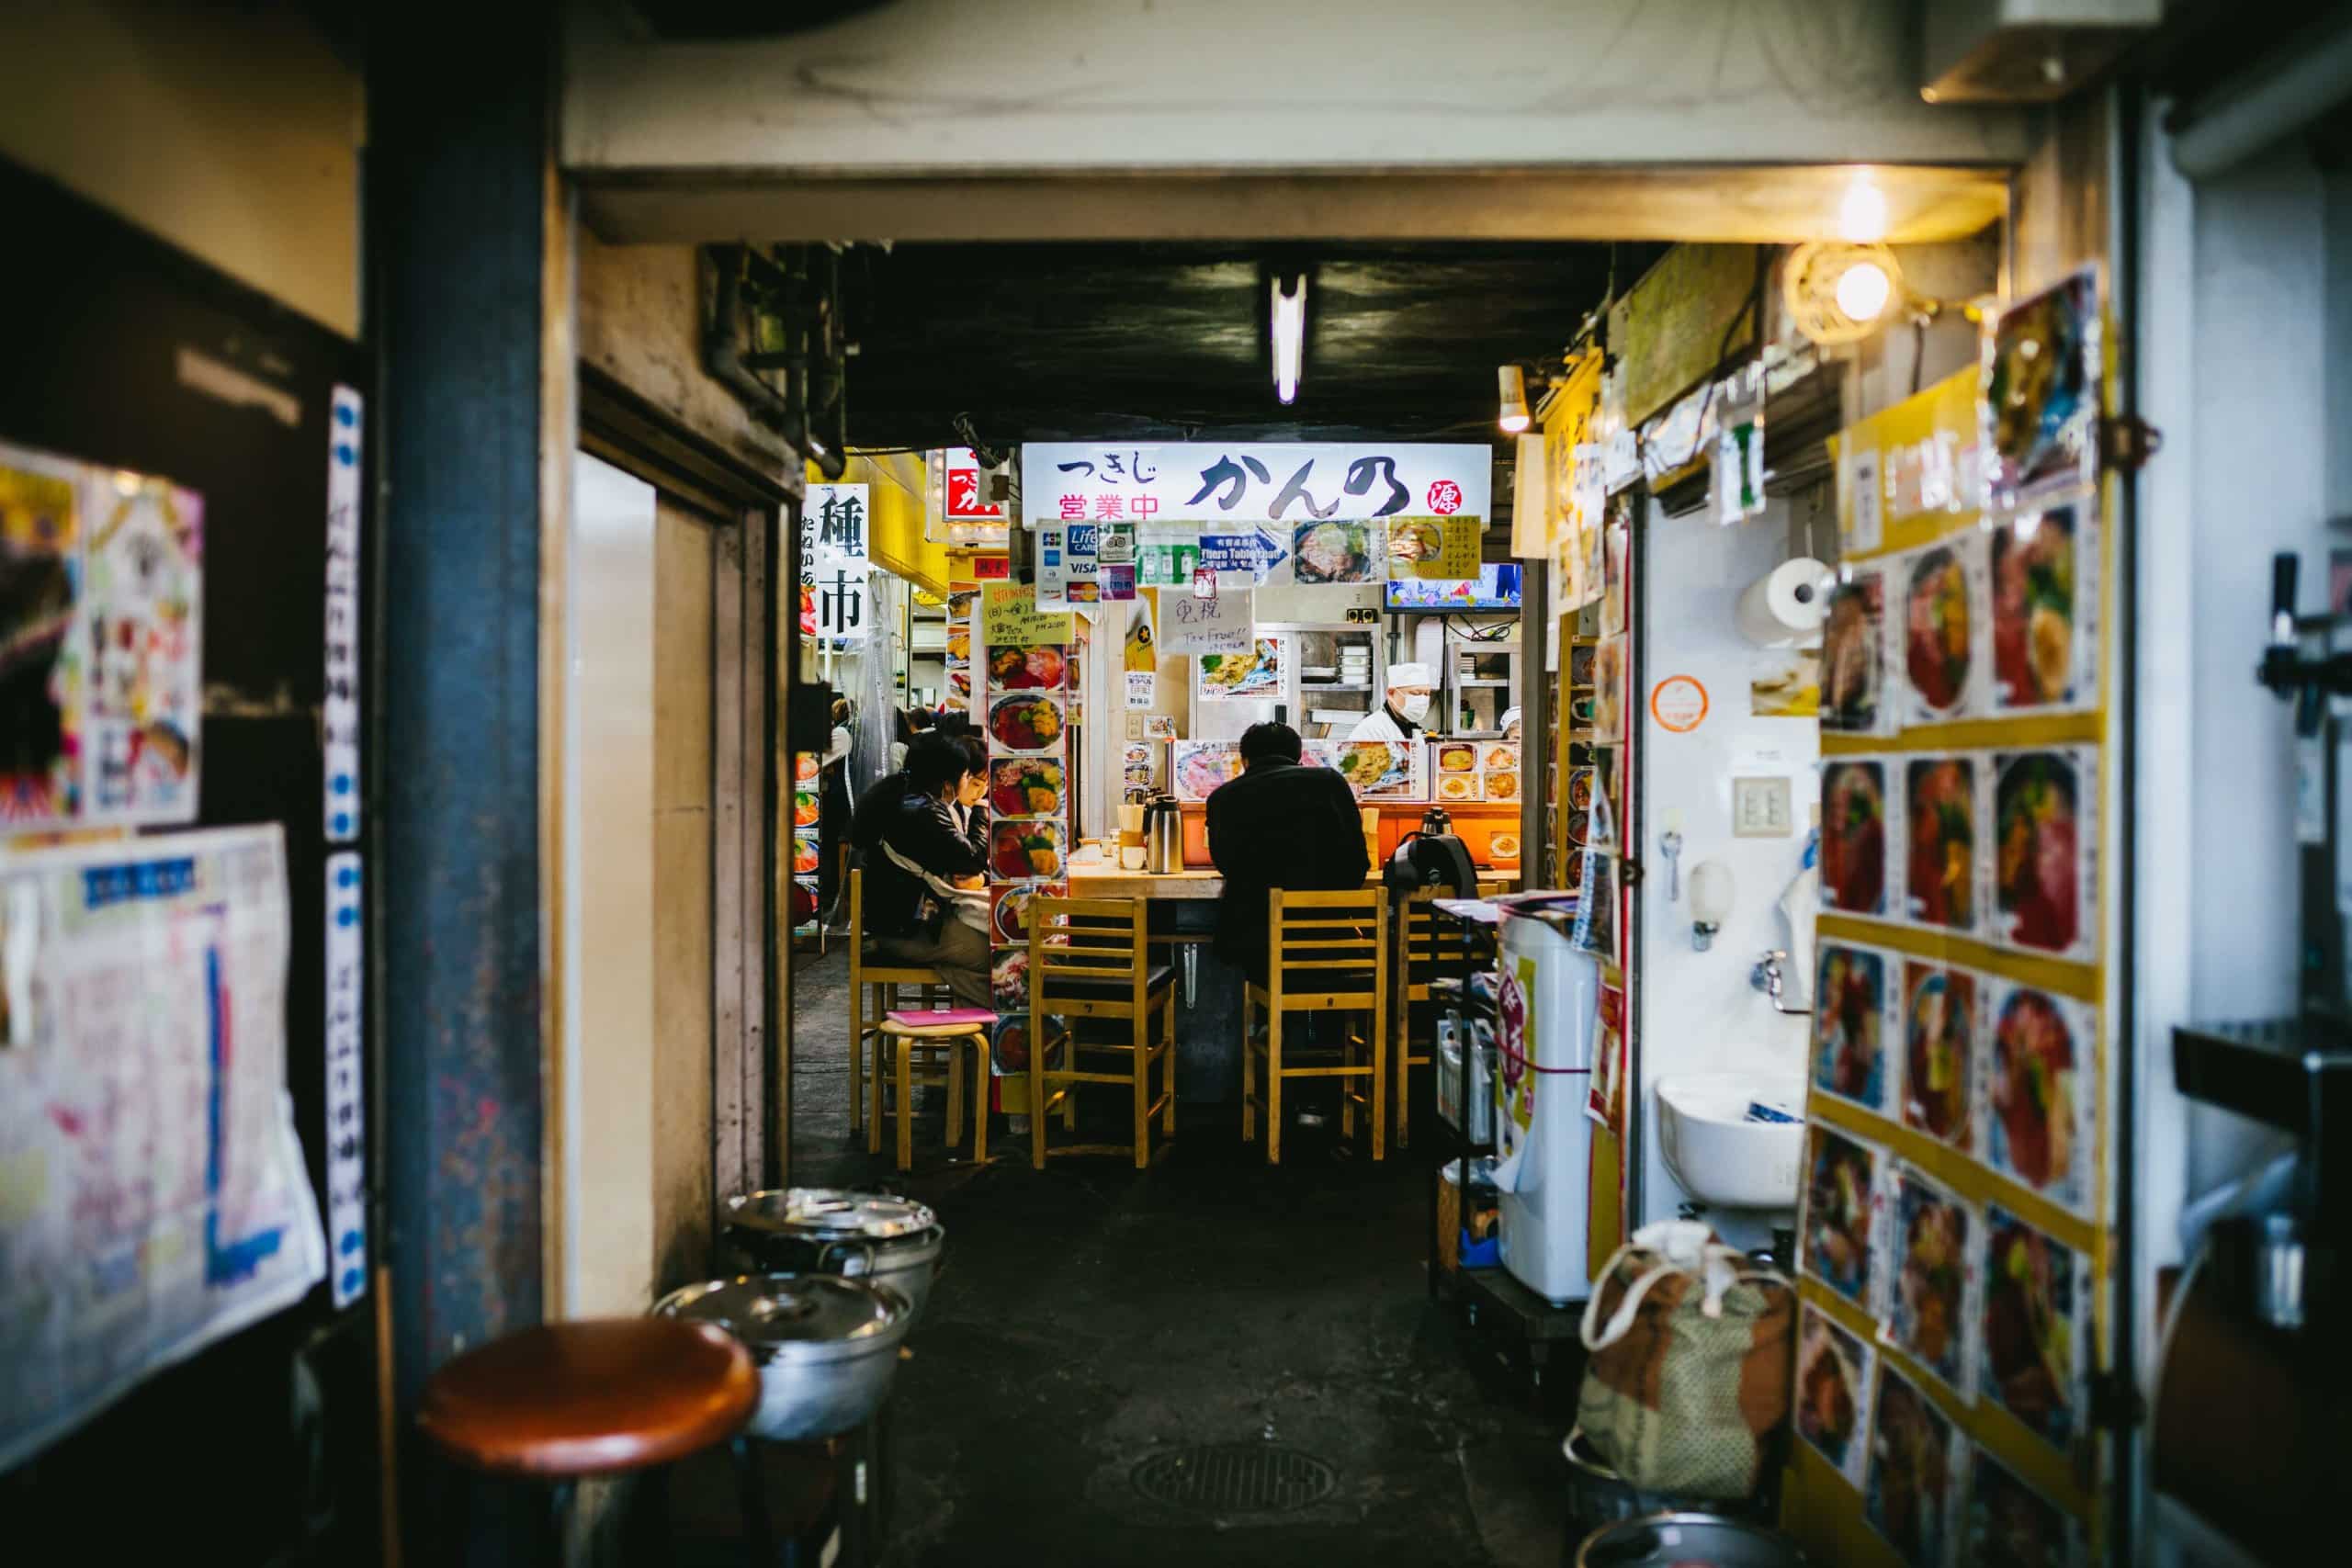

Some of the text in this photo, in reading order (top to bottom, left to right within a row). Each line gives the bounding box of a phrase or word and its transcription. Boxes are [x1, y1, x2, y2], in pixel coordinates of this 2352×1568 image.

[1057, 451, 1157, 483] つきじ
[1059, 493, 1159, 521] 営業中
[819, 496, 866, 634] 種市
[1070, 563, 1097, 574] VISA
